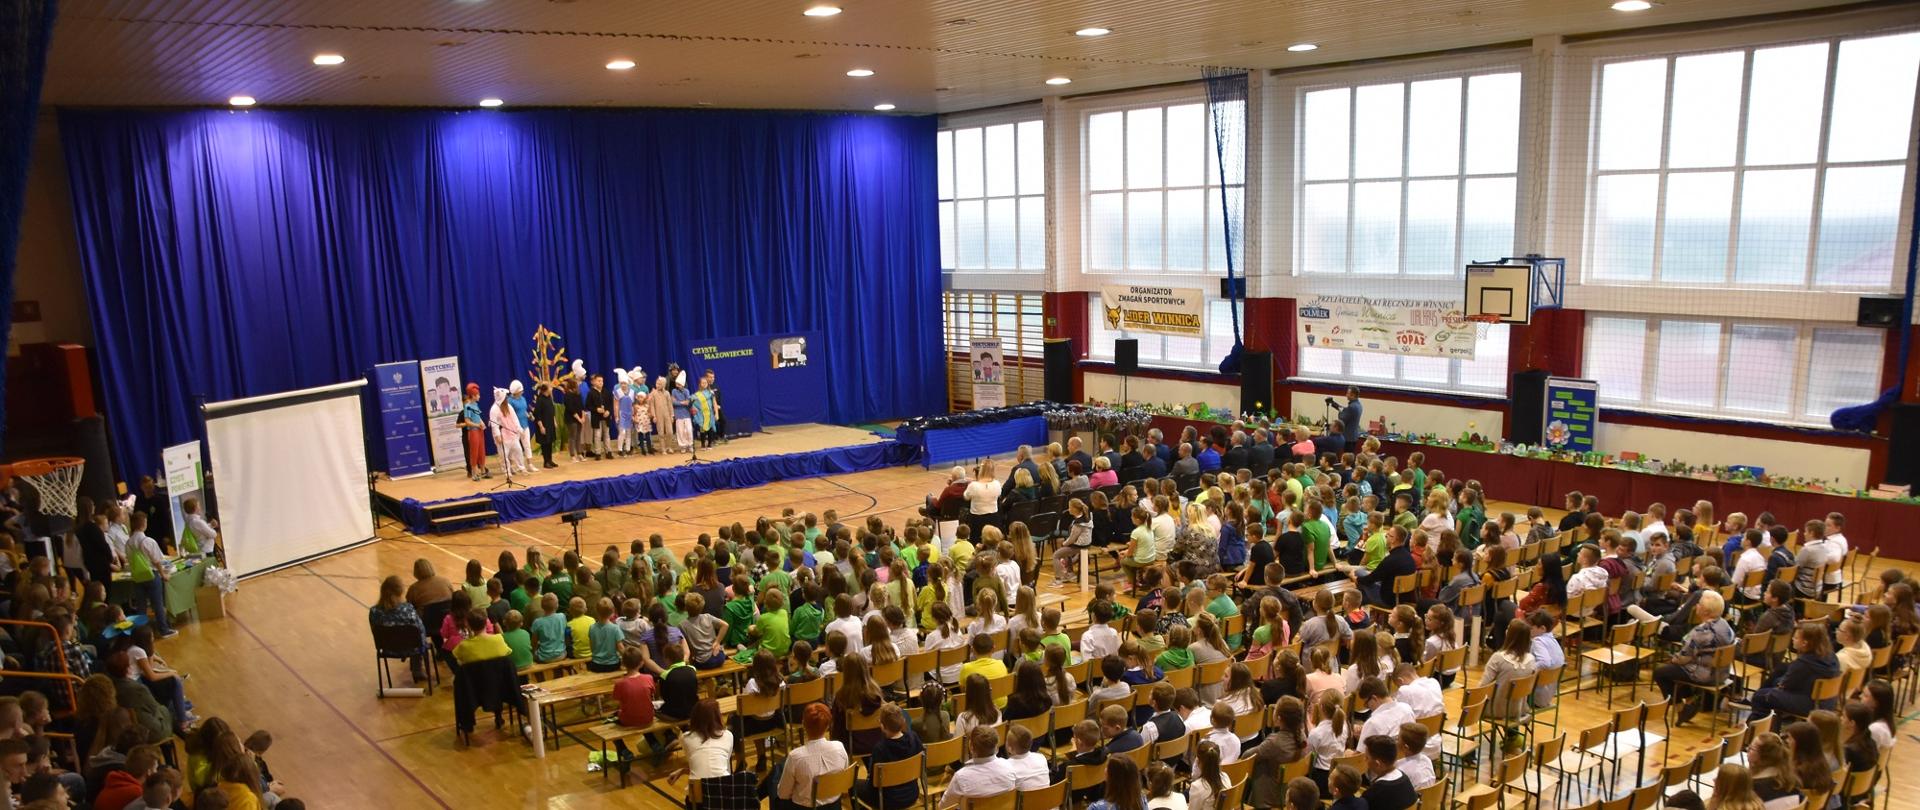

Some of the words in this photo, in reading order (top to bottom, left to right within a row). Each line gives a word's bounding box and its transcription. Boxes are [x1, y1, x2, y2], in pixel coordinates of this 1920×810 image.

[1130, 286, 1172, 296] ORGANIZATOR
[1118, 294, 1142, 303] ZMAGAŃ
[1143, 296, 1185, 305] SPORTOWYCH
[1318, 295, 1360, 305] PRZYJACIELE
[1423, 300, 1456, 309] WINNICY
[1123, 309, 1151, 323] LIDER
[1152, 311, 1200, 327] WINNICA
[1300, 308, 1328, 317] POLMLEK
[1396, 334, 1426, 345] TOPAZ
[704, 349, 753, 360] MAZOWIECKIE
